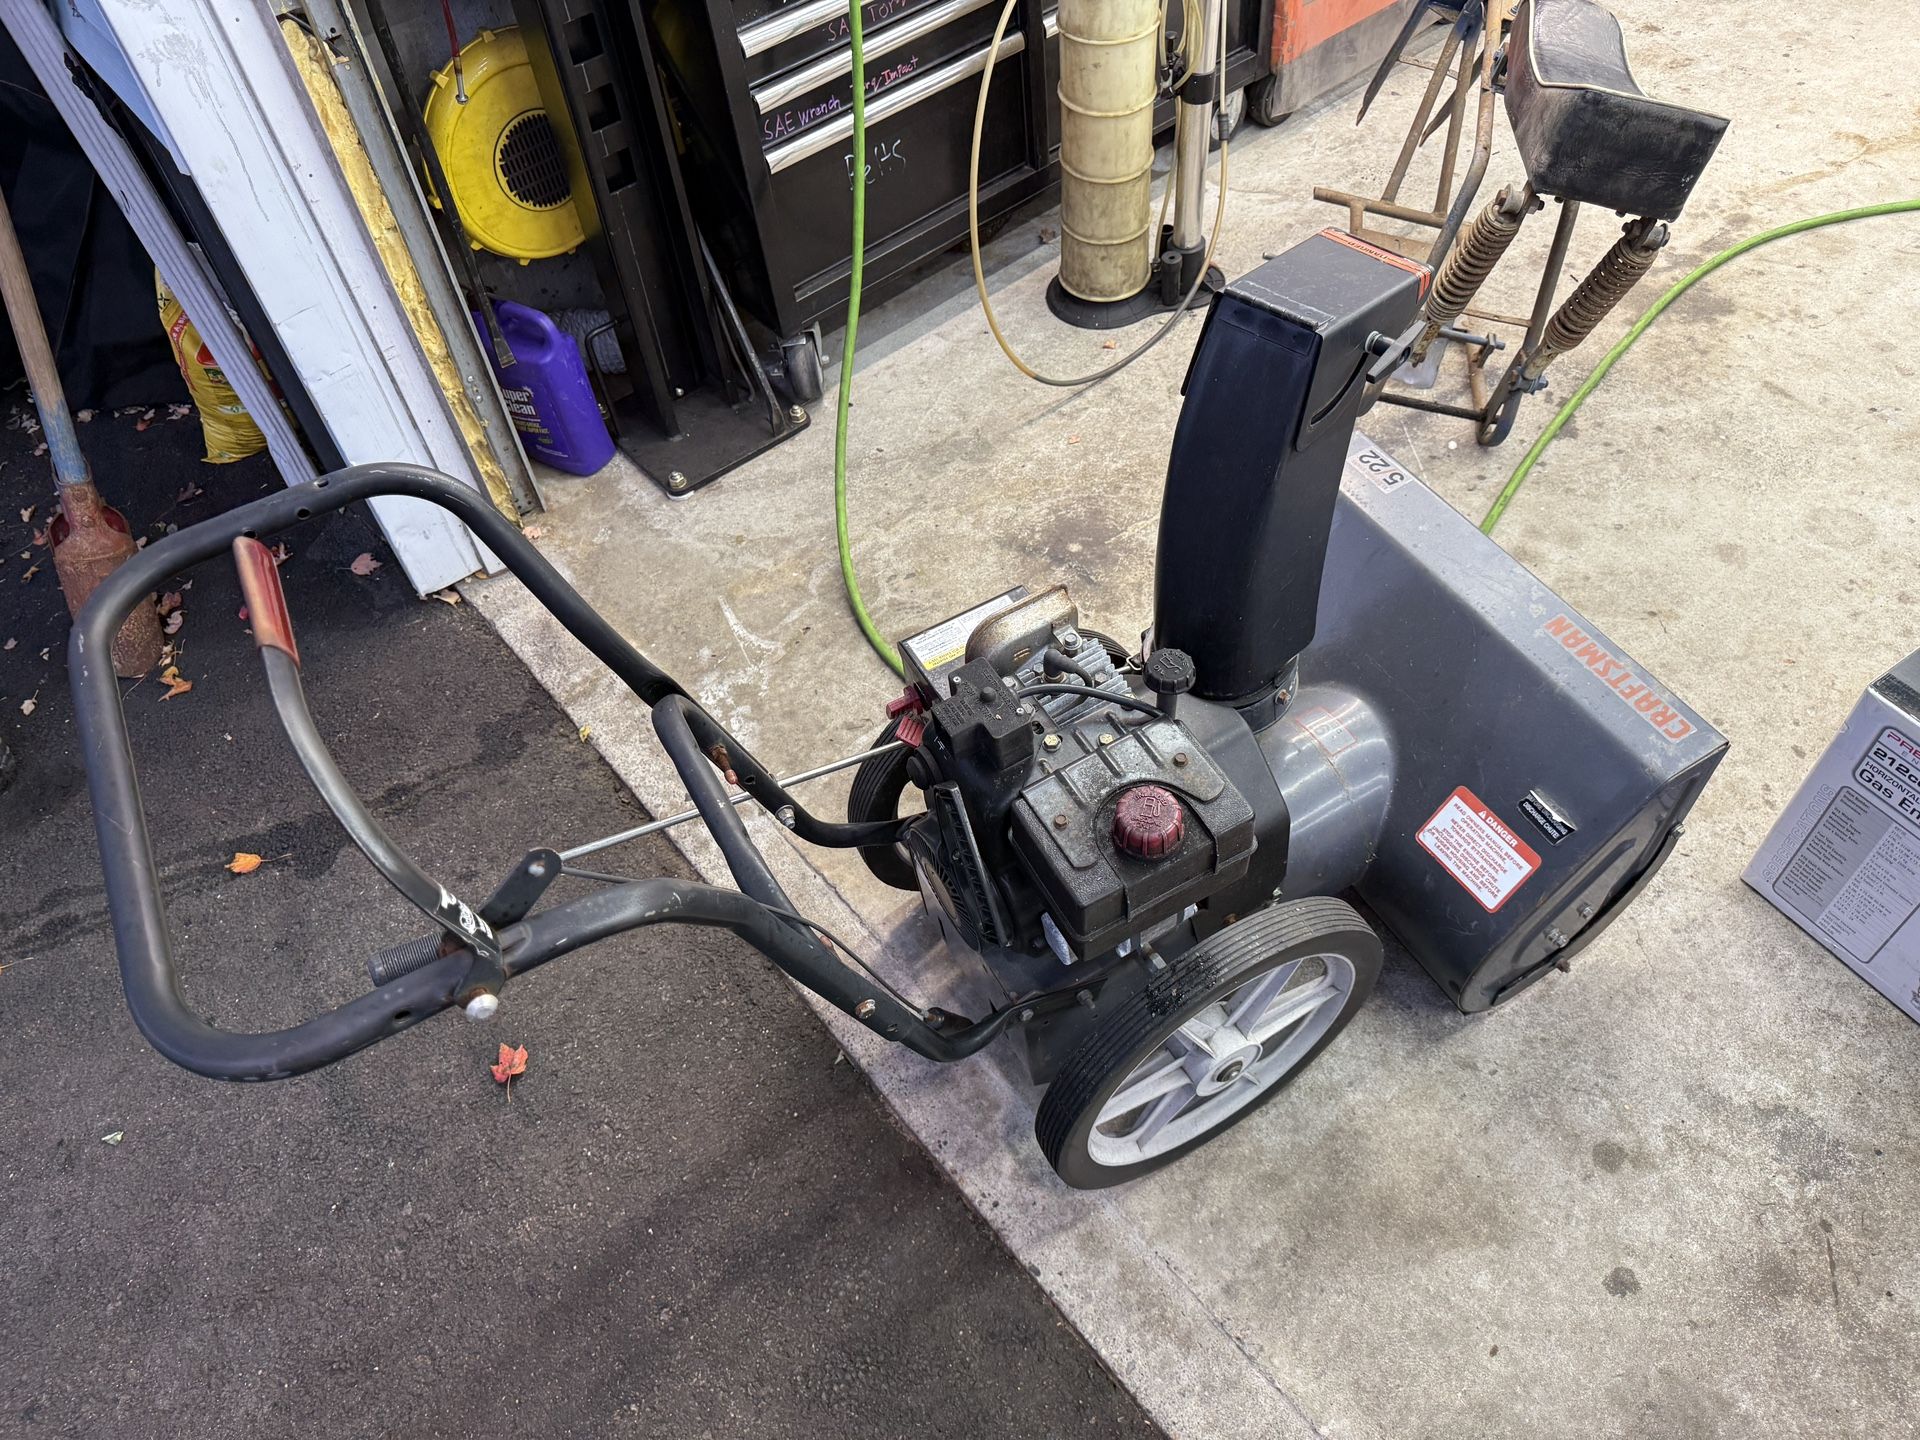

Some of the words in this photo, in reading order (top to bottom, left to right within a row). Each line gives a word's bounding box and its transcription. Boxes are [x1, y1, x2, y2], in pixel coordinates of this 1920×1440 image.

[827, 17, 850, 42] SA
[764, 110, 795, 141] SAE
[798, 95, 842, 127] Wrench
[502, 389, 529, 403] uper
[1358, 450, 1405, 486] 5/22
[1545, 615, 1692, 738] CRAFTSMAN
[1859, 768, 1894, 799] Gas
[1865, 761, 1920, 805] HORIZONTAL
[1873, 747, 1920, 788] 212c
[1460, 817, 1485, 841] OPERATING
[1485, 816, 1517, 847] DANGER
[1521, 801, 1546, 825] DISCHARGE
[1763, 784, 1835, 882] SPECIFICATIONS
[1441, 828, 1453, 839] STOP
[1453, 839, 1463, 848] THE
[1462, 848, 1480, 865] ENGINE
[1479, 864, 1498, 882] BEFORE
[1449, 825, 1471, 846] TOWARDS
[1449, 818, 1465, 833] NEVER
[1464, 832, 1482, 848] DIRECT
[1480, 847, 1508, 874] DISCHARGE
[1453, 803, 1466, 815] READ
[1503, 851, 1523, 870] BEFORE
[1431, 826, 1460, 853] UNCLOGGING
[1459, 852, 1485, 878] DISCHARGE
[1484, 877, 1501, 893] CHUTE
[1433, 843, 1452, 861] LEAVING
[1452, 861, 1461, 870] THE
[1434, 836, 1450, 851] AUGER
[1449, 850, 1470, 870] HOUSING
[1469, 870, 1480, 880] AND
[1478, 879, 1498, 898] BEFORE
